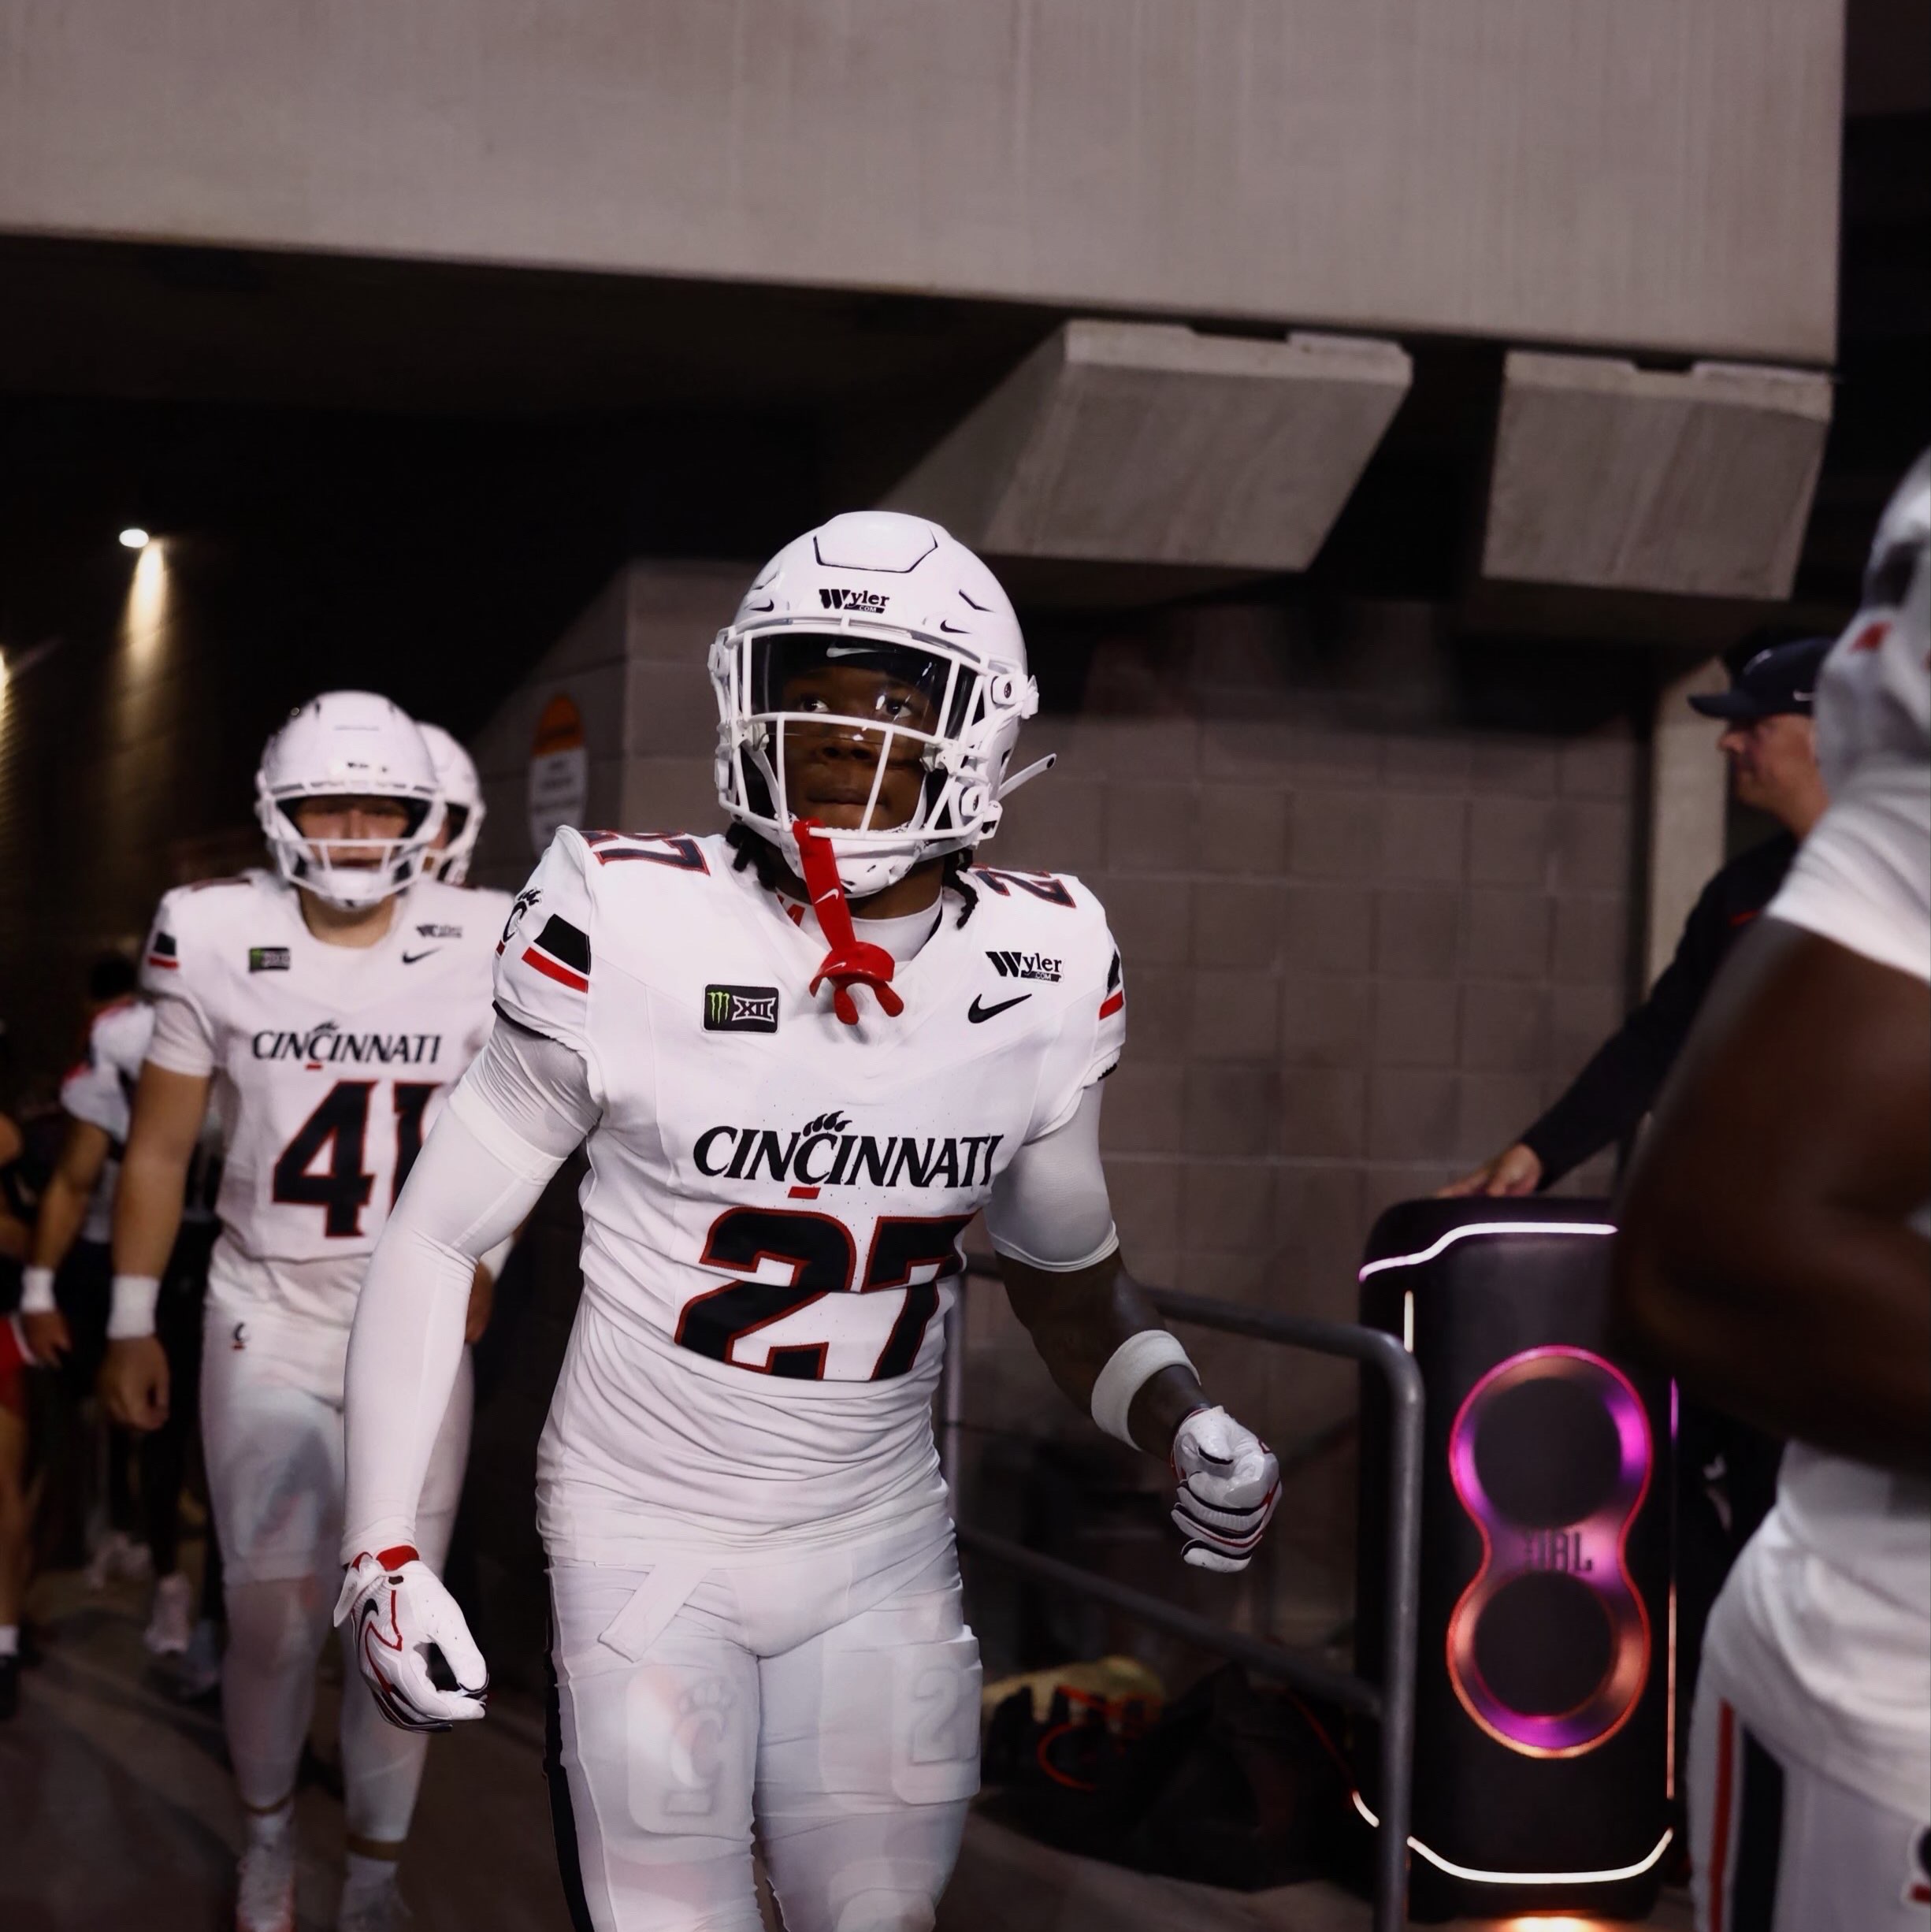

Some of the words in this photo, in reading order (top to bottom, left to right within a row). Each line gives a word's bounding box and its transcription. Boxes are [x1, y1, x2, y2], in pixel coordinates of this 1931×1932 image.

[819, 589, 890, 609] Wyler
[985, 951, 1062, 977] Wyler
[252, 1026, 443, 1064] CINCINNATI
[273, 1080, 443, 1237] 41
[693, 1114, 1004, 1187] CINCINNATI
[674, 1206, 983, 1382] 27
